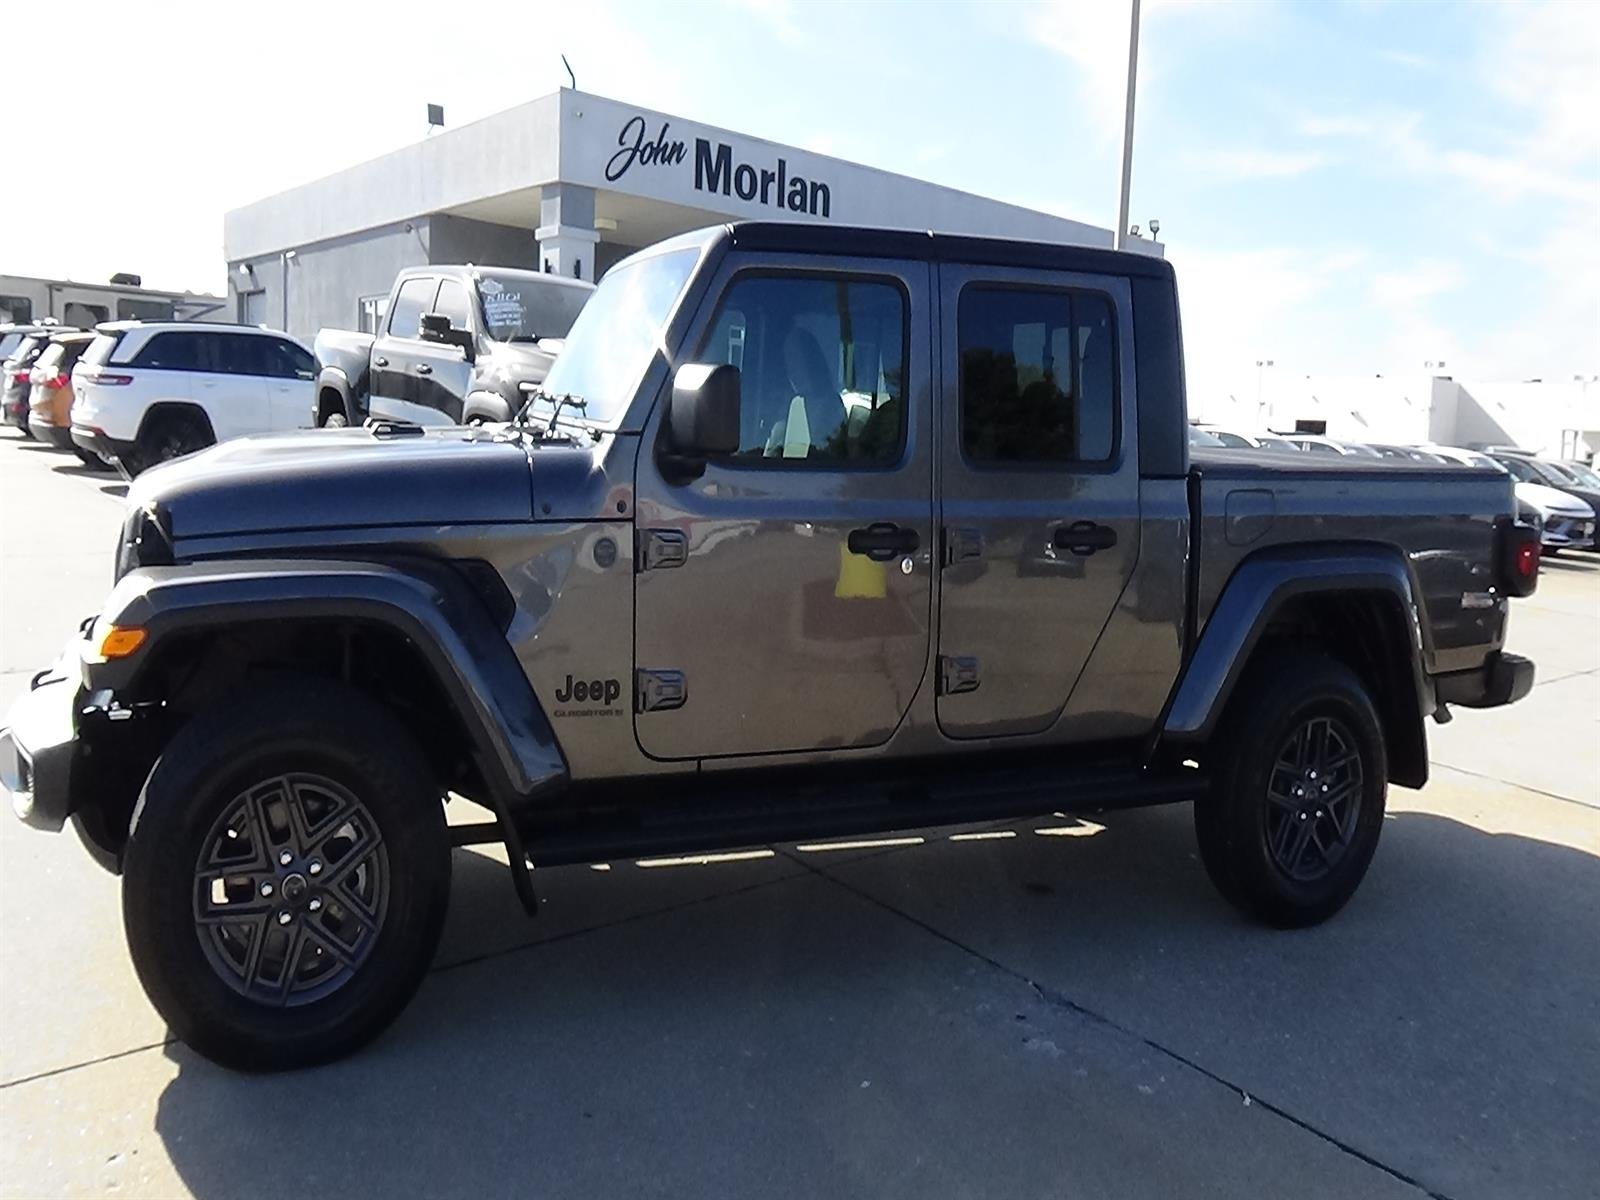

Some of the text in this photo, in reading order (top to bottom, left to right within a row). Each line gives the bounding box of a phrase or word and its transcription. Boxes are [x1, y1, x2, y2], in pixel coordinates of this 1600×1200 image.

[605, 116, 830, 218] John Morlan
[555, 674, 620, 706] Jeep
